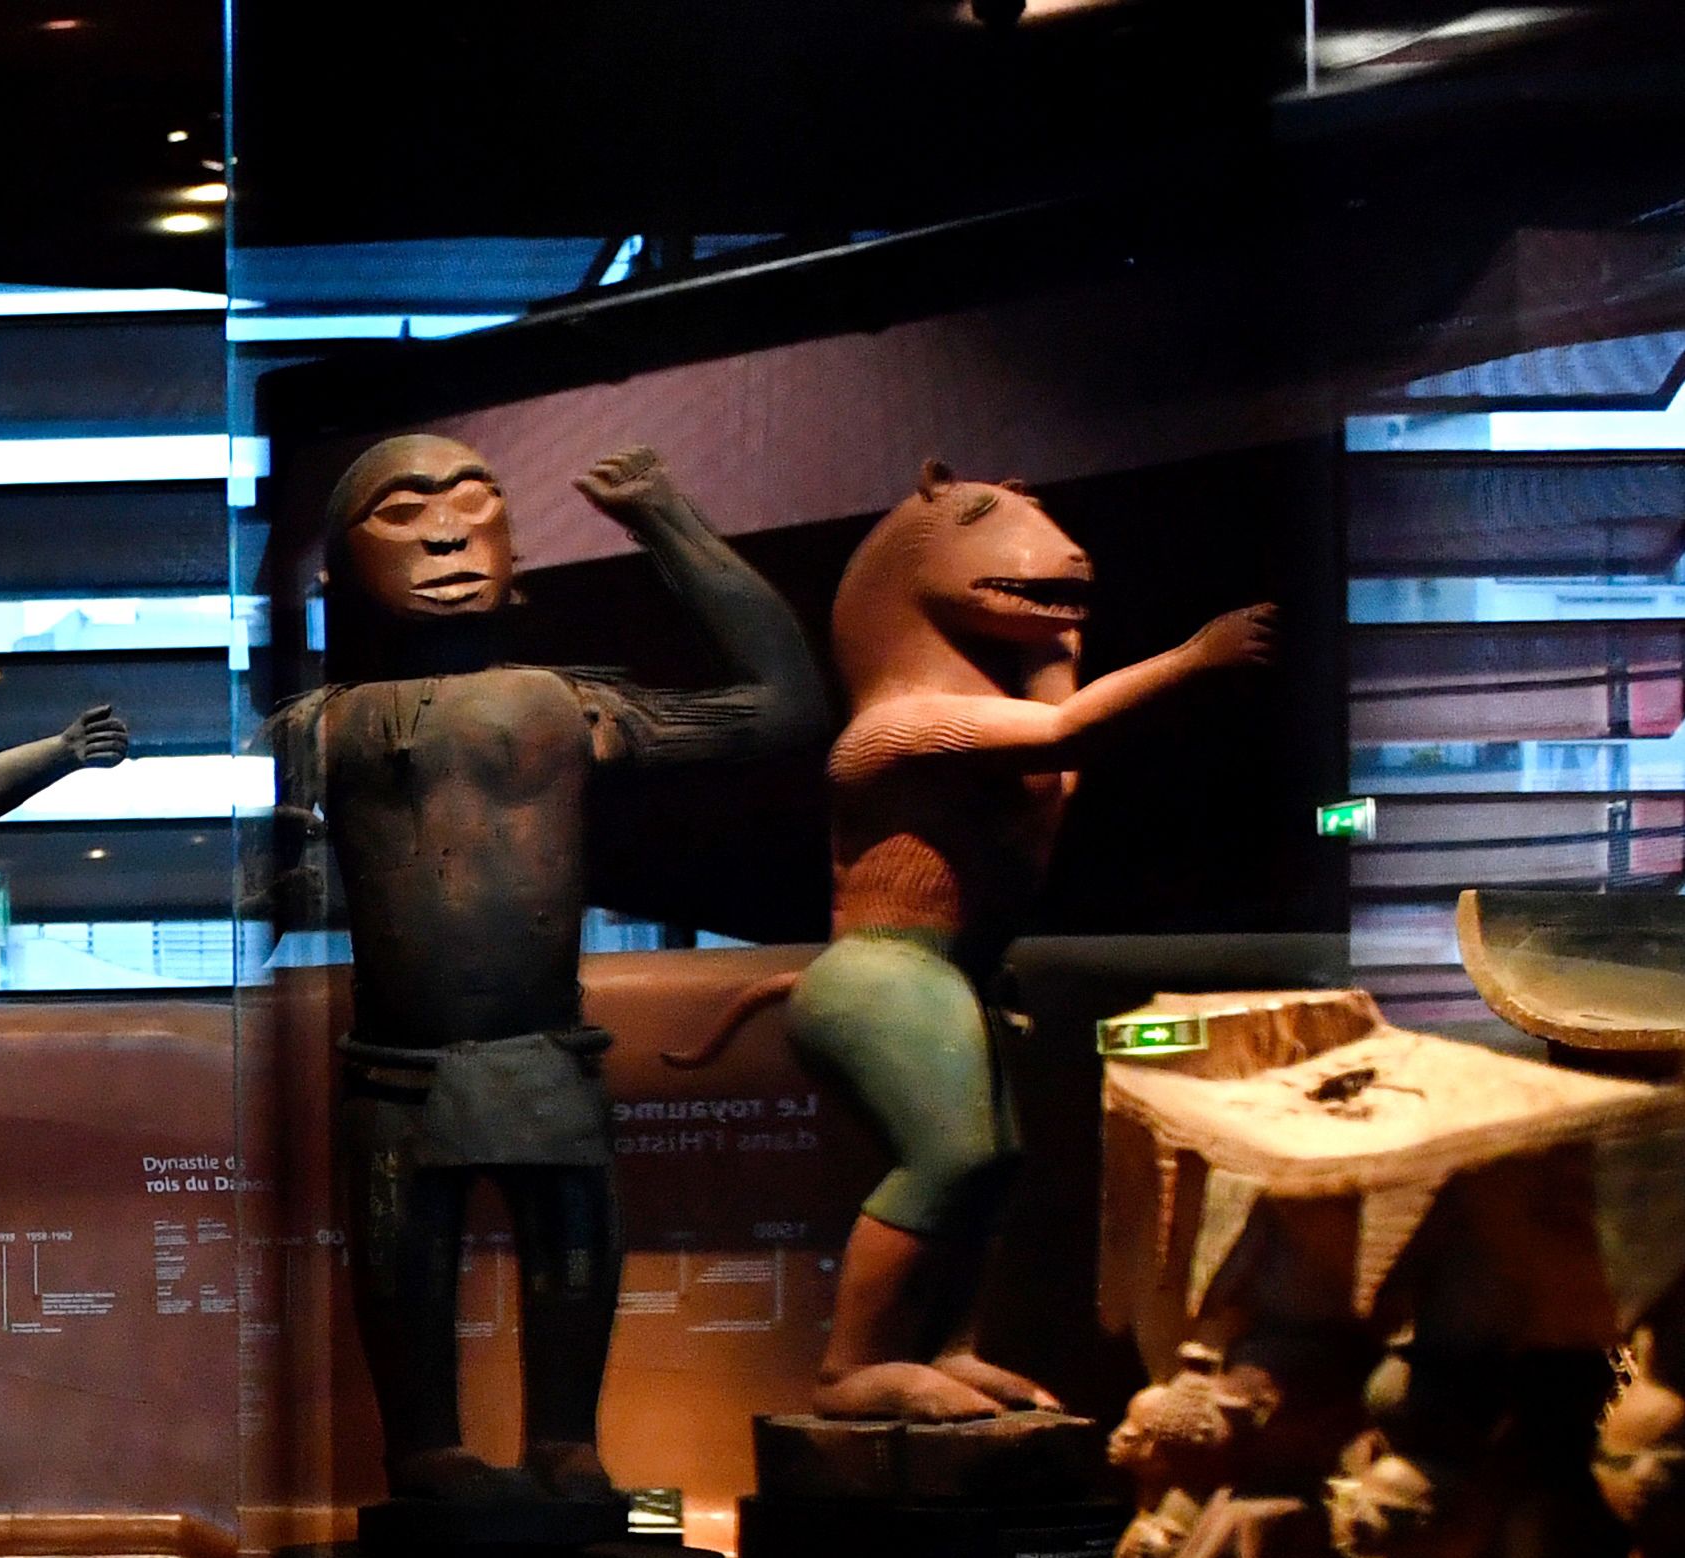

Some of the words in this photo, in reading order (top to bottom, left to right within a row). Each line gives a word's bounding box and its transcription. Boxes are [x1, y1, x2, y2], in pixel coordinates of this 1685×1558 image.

[142, 1154, 220, 1174] Dynastie
[145, 1175, 180, 1193] rois
[185, 1176, 209, 1192] du
